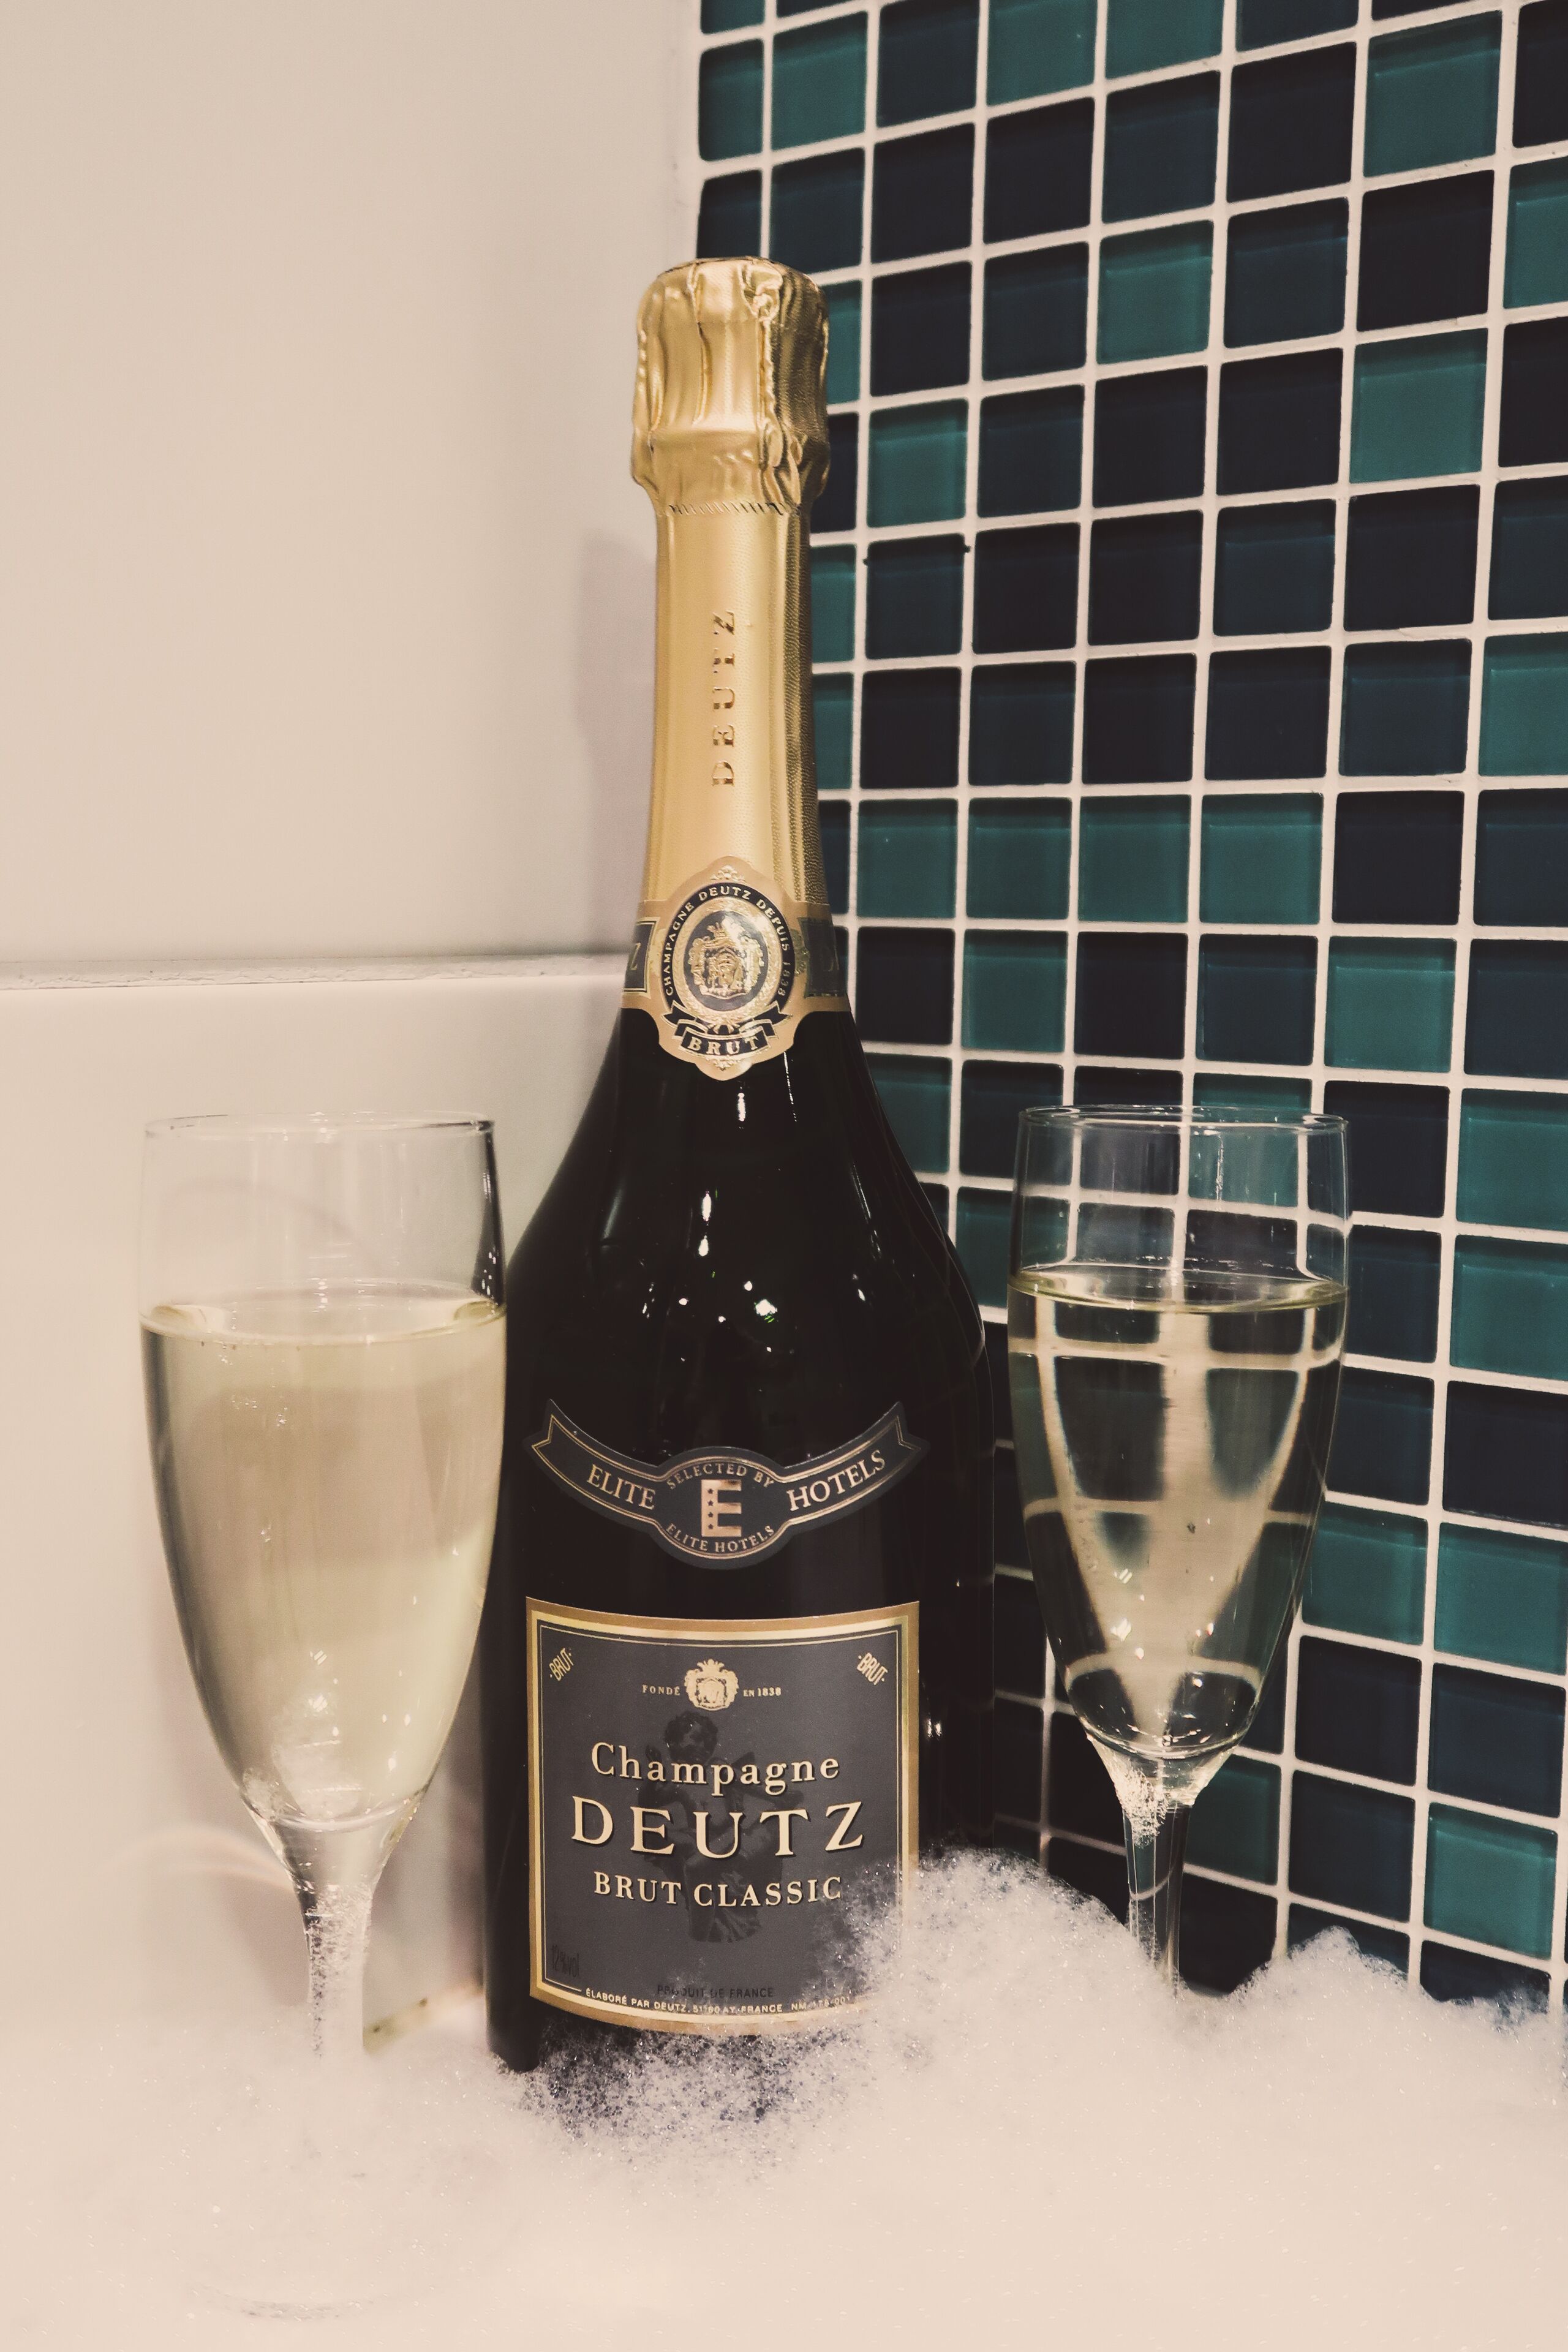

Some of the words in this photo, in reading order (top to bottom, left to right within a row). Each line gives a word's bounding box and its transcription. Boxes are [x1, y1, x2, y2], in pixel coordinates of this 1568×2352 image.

[712, 609, 736, 786] DEUTZ
[663, 903, 695, 997] CHAMPAGNE
[698, 886, 752, 902] DEUTZ
[756, 899, 790, 951] DEPUIS
[777, 960, 791, 997] 1838
[687, 1036, 760, 1056] BRUT
[586, 1463, 656, 1510] ELITE
[786, 1449, 886, 1512] HOTELS
[666, 1463, 747, 1490] SELECTED
[753, 1471, 774, 1488] BY
[701, 1479, 742, 1537] E
[665, 1523, 709, 1551] ELITE
[714, 1525, 775, 1553] HOTELS
[742, 1689, 755, 1697] EN
[757, 1686, 782, 1697] 1838
[591, 1741, 840, 1797] Champagne
[571, 1795, 865, 1859] DEUTZ
[594, 1871, 682, 1907] BRUT
[693, 1875, 842, 1907] CLASSIC
[586, 1987, 627, 2005] ÉLABORÉ
[631, 1997, 650, 2008] PAR
[729, 1988, 774, 1999] FRANCE
